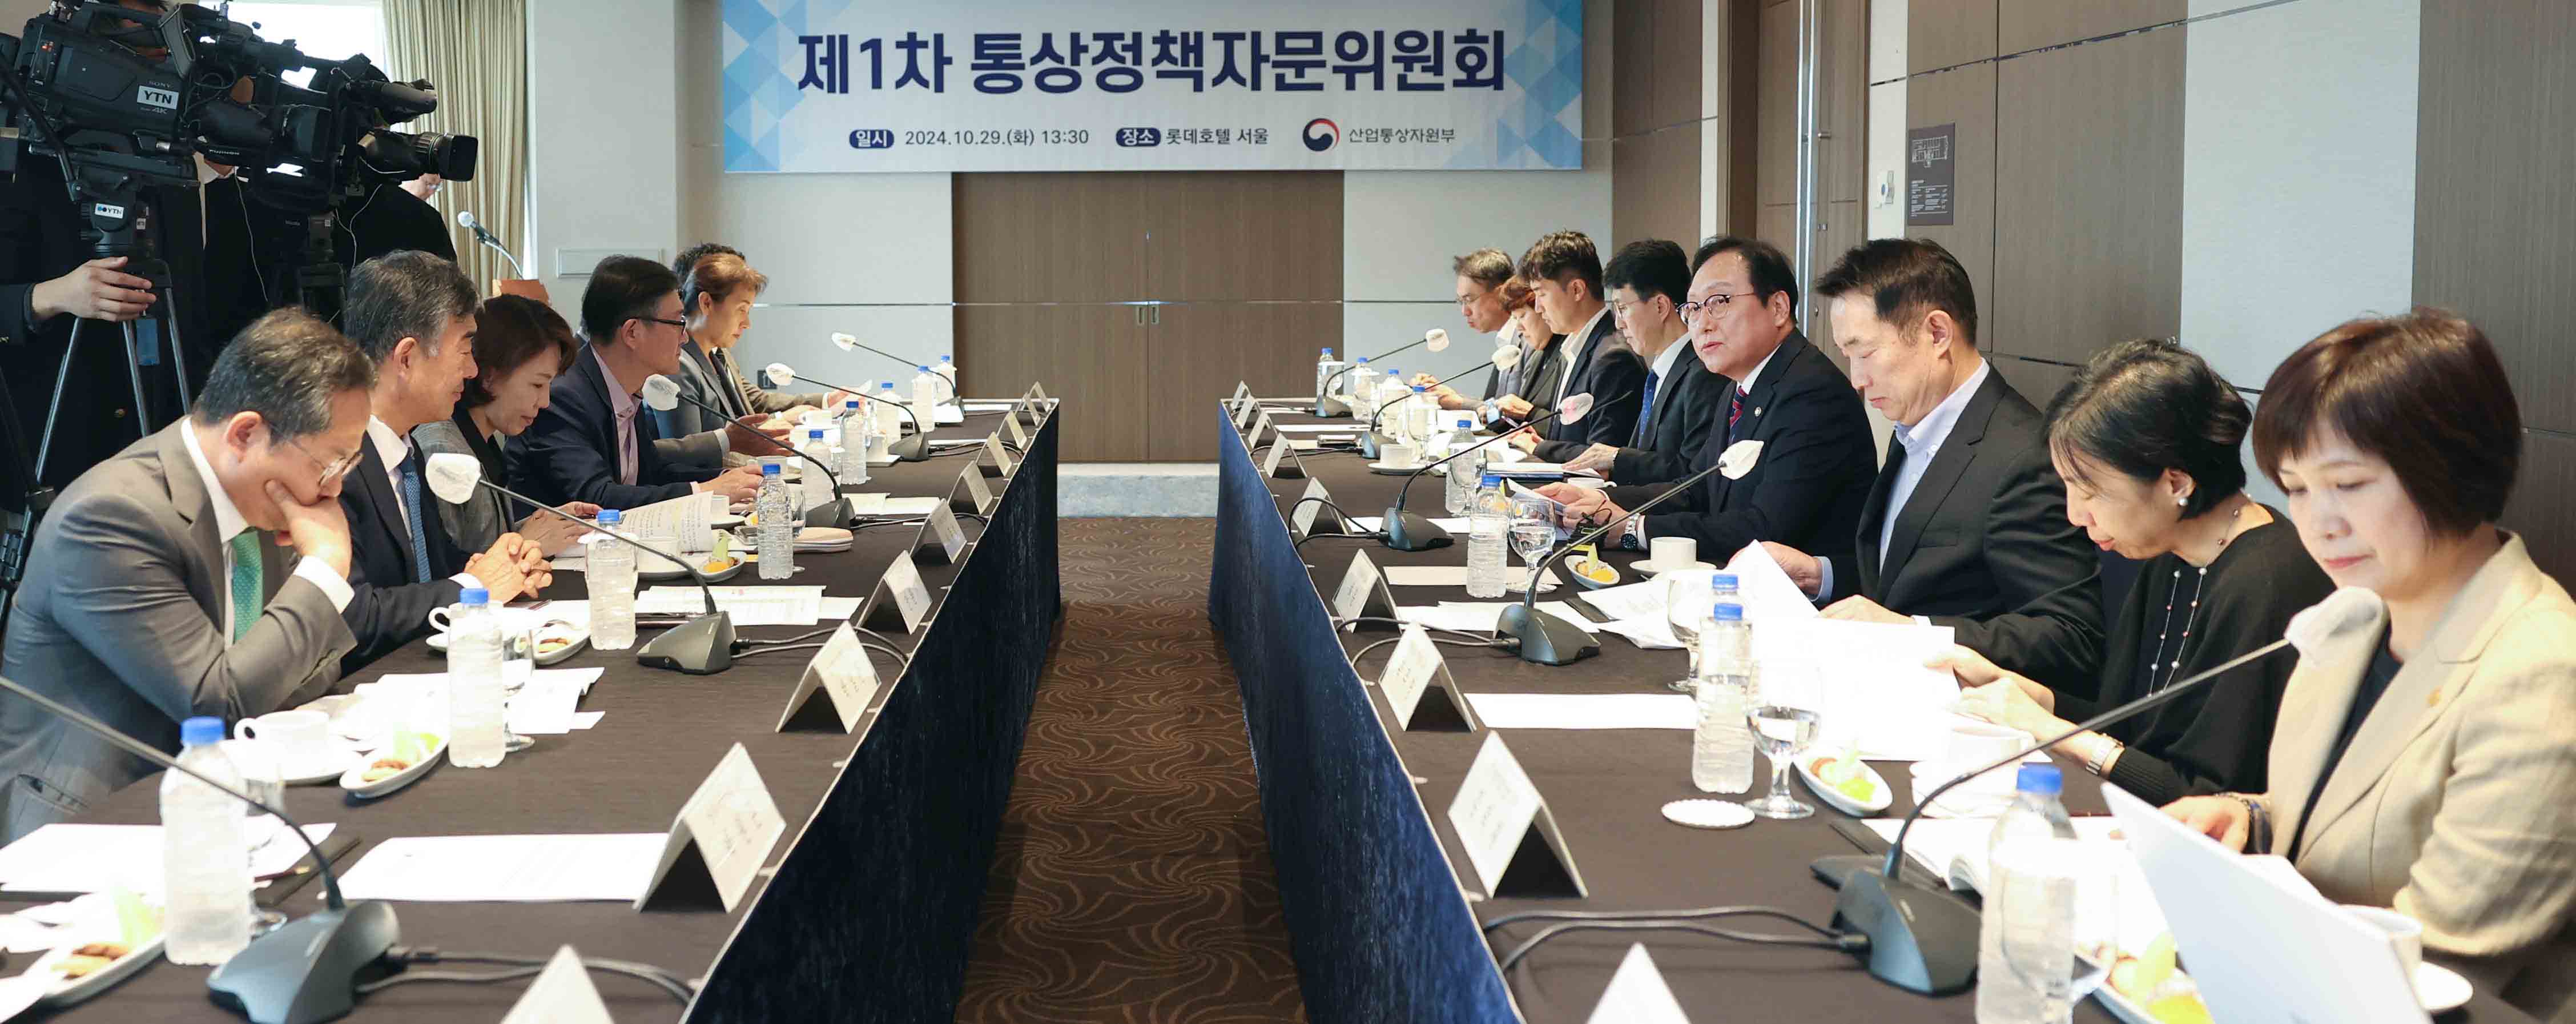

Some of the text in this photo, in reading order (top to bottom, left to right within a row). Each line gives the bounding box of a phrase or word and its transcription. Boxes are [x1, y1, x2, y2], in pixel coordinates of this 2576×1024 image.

[798, 29, 1505, 94] 제1차 통상정책자문위원회
[144, 90, 172, 104] YTN
[856, 128, 1270, 147] 일시 2024.10.29.(화) 13:30 장소 롯데호텔 서울
[1349, 127, 1456, 144] 산업통상자원부
[108, 207, 122, 215] YTN
